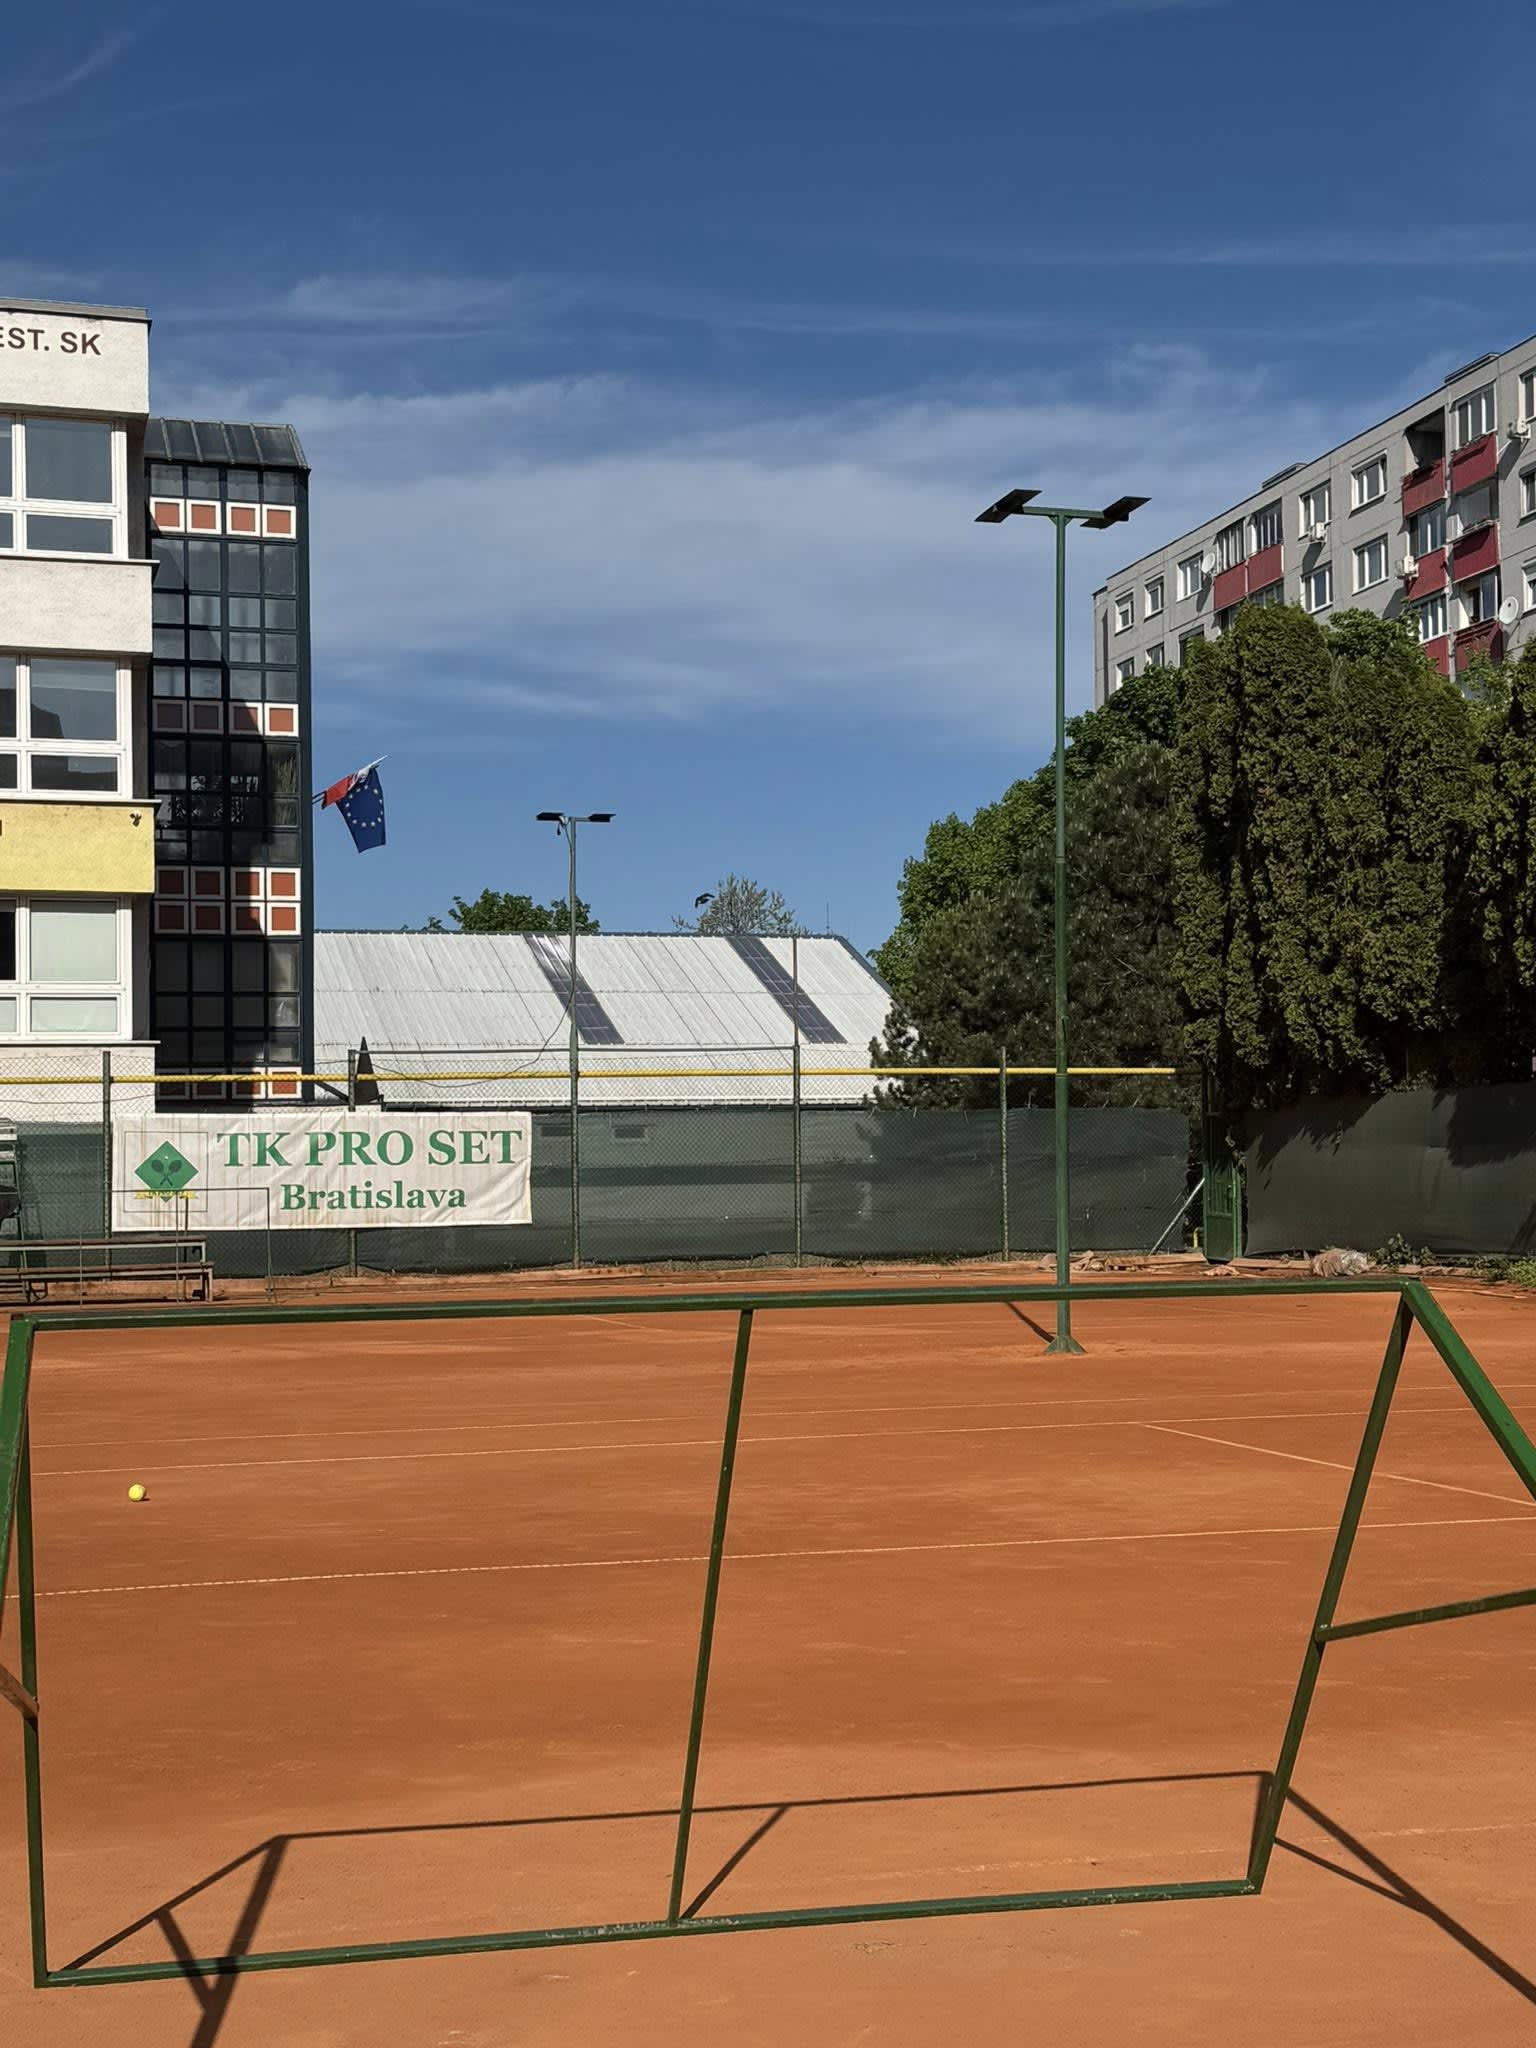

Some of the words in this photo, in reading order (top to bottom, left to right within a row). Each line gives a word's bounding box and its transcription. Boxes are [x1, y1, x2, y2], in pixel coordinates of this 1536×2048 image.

[0, 326, 49, 351] ST.
[60, 331, 101, 355] SK
[216, 1131, 292, 1167] TK
[304, 1130, 414, 1166] PRO
[428, 1129, 523, 1166] SET
[280, 1180, 467, 1210] Bratislava
